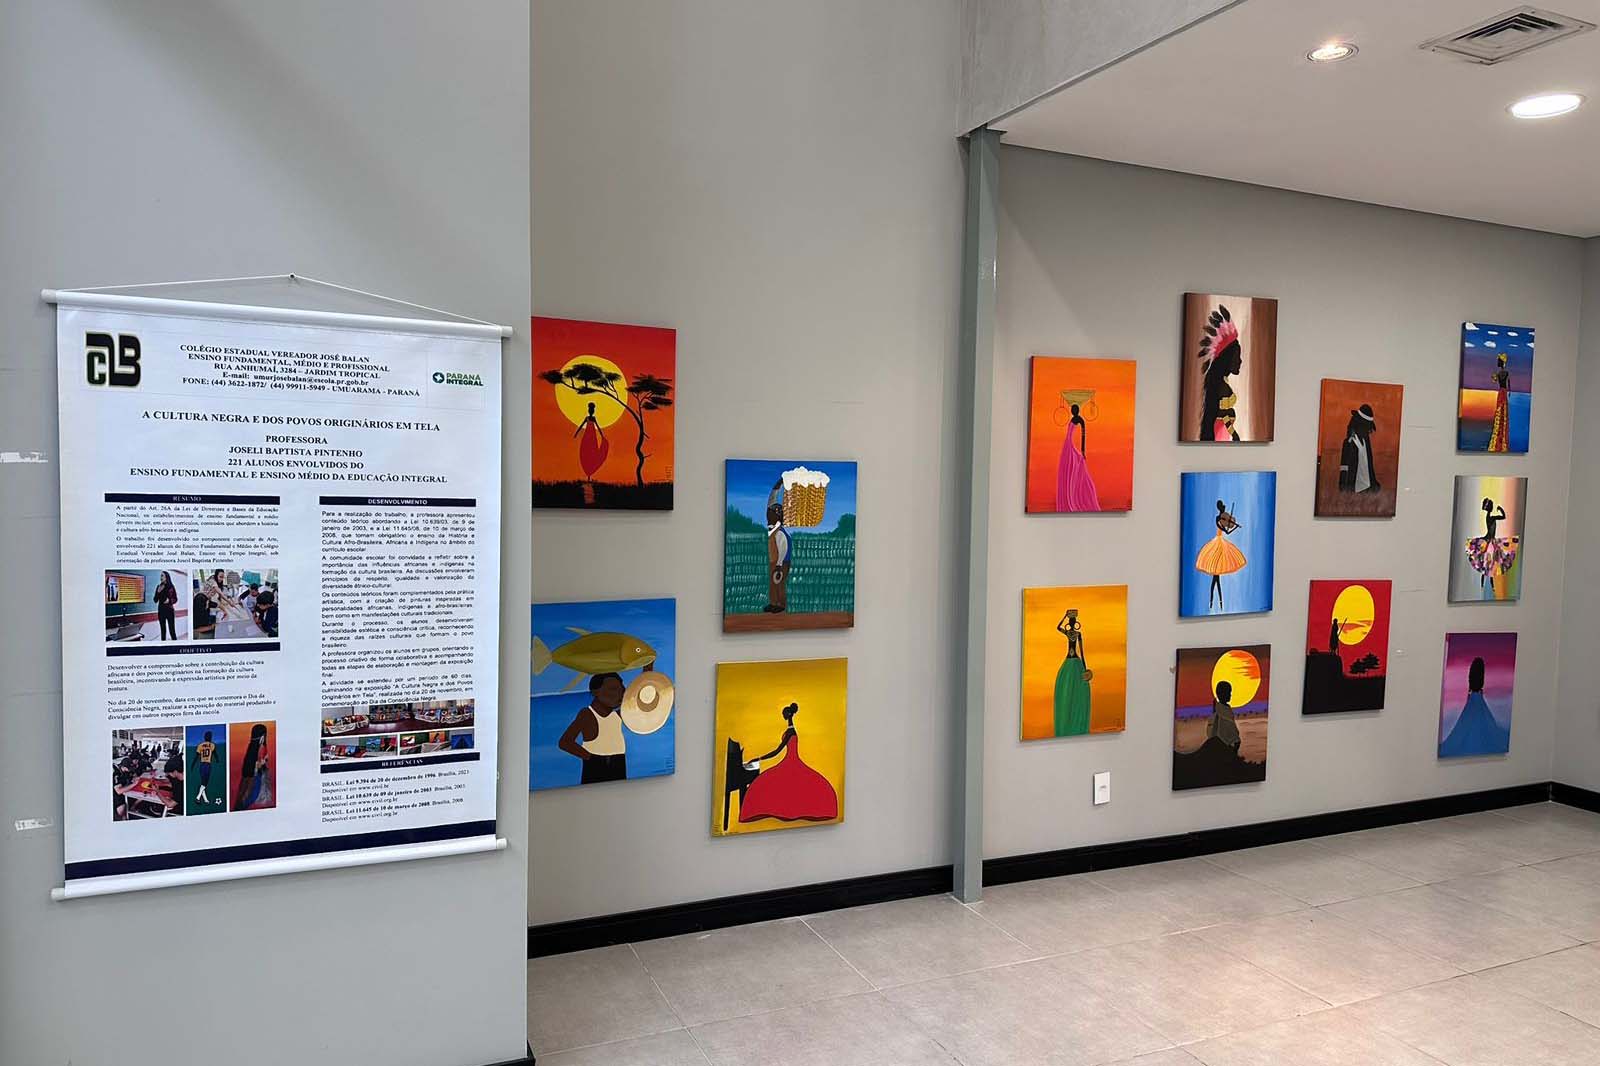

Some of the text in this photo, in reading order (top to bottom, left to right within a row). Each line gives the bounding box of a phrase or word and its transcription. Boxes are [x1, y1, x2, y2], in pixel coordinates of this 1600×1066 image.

[180, 343, 370, 363] COLÉGIO ESTADUAL VEREADOR JOSÉ BALAN
[188, 354, 221, 363] ENSINO
[293, 359, 321, 368] MÉDIO
[330, 362, 389, 372] PROFISSIONAL
[304, 368, 336, 376] JARDIM
[339, 370, 379, 378] TROPICAL
[182, 378, 209, 386] FONE:
[211, 379, 226, 388] (44)
[270, 382, 284, 391] (44)
[285, 383, 325, 392] 99911-5949
[332, 385, 380, 395] UMUARAMA
[387, 386, 419, 397] PARANÁ
[142, 411, 439, 431] A CULTURA NEGRA E DOS POVOS ORIGINÁRIOS EM TELA
[266, 436, 327, 444] PROFESSORA
[228, 446, 362, 458] JOSELI BAPTISTA PINTENHO
[286, 460, 348, 469] ENVOLVIDOS
[130, 468, 168, 477] ENSINO
[171, 469, 248, 479] FUNDAMENTAL
[259, 471, 295, 480] ENSINO
[298, 471, 330, 481] MÉDIO
[332, 473, 344, 481] DA
[347, 472, 399, 483] EDUCAÇÃO
[401, 475, 447, 483] INTEGRAL
